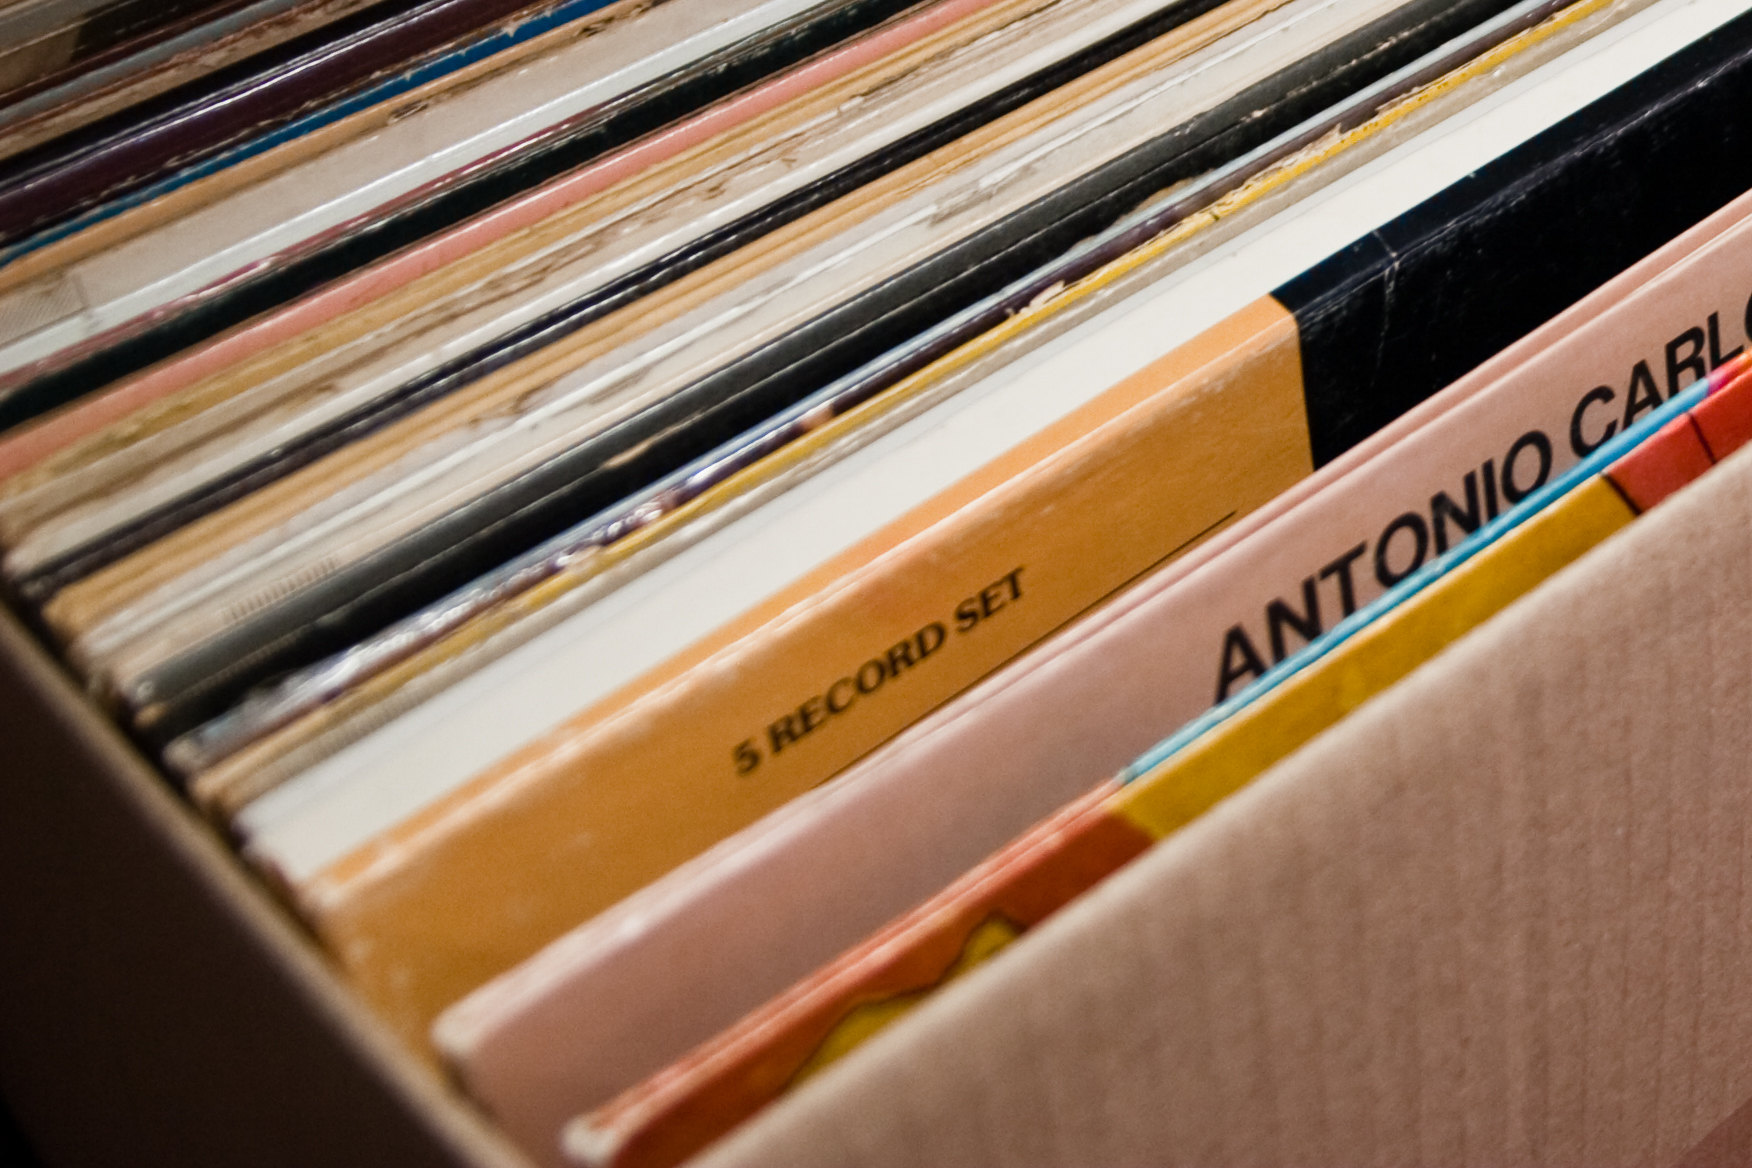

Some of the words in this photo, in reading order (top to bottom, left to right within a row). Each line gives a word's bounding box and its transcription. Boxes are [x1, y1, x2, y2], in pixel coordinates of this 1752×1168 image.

[733, 738, 760, 777] 5
[766, 620, 948, 754] RECORD
[953, 564, 1026, 634] SET
[1214, 429, 1554, 706] ANTONIO
